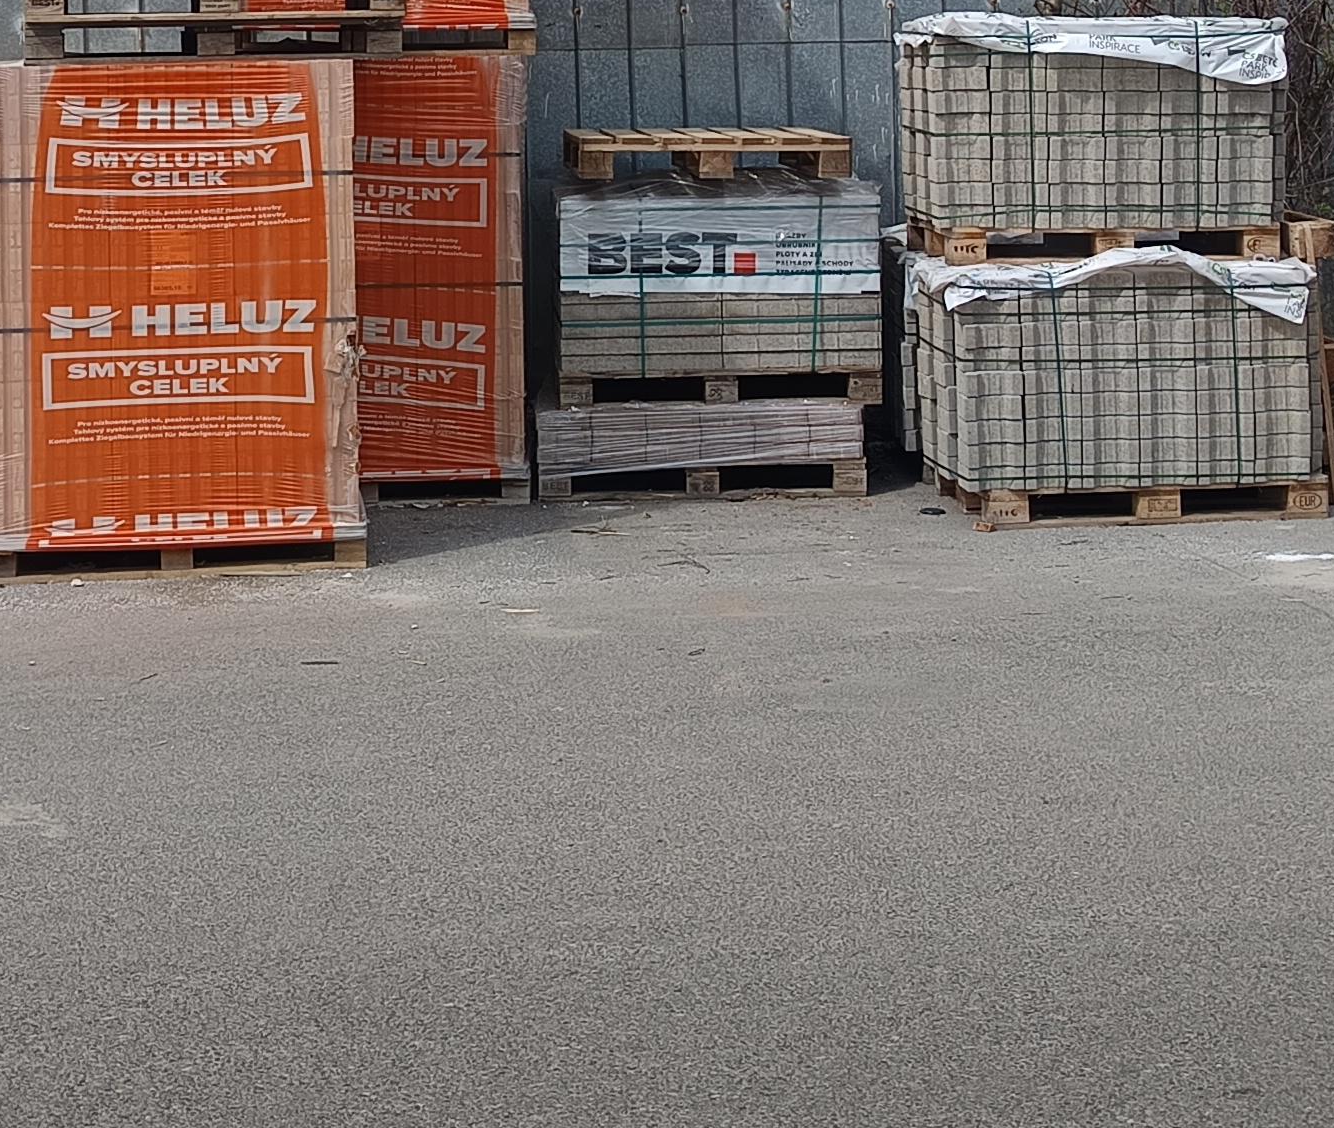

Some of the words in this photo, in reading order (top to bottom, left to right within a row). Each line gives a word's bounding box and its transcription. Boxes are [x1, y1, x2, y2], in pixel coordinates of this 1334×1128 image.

[1089, 41, 1141, 54] INSPIRACE
[1241, 61, 1267, 72] PARK
[136, 93, 307, 130] HELUZ
[71, 144, 278, 168] SMYSLUPLNÝ
[131, 168, 228, 188] CELEK
[354, 199, 414, 217] ELEK
[588, 232, 738, 275] BEST
[131, 299, 317, 338] HELUZ
[362, 316, 487, 353] ELUZ
[67, 353, 283, 379] SMYSLUPLNÝ
[129, 376, 230, 396] CELEK
[255, 415, 282, 423] stavby
[259, 422, 286, 430] stavby
[1298, 495, 1316, 507] EUR
